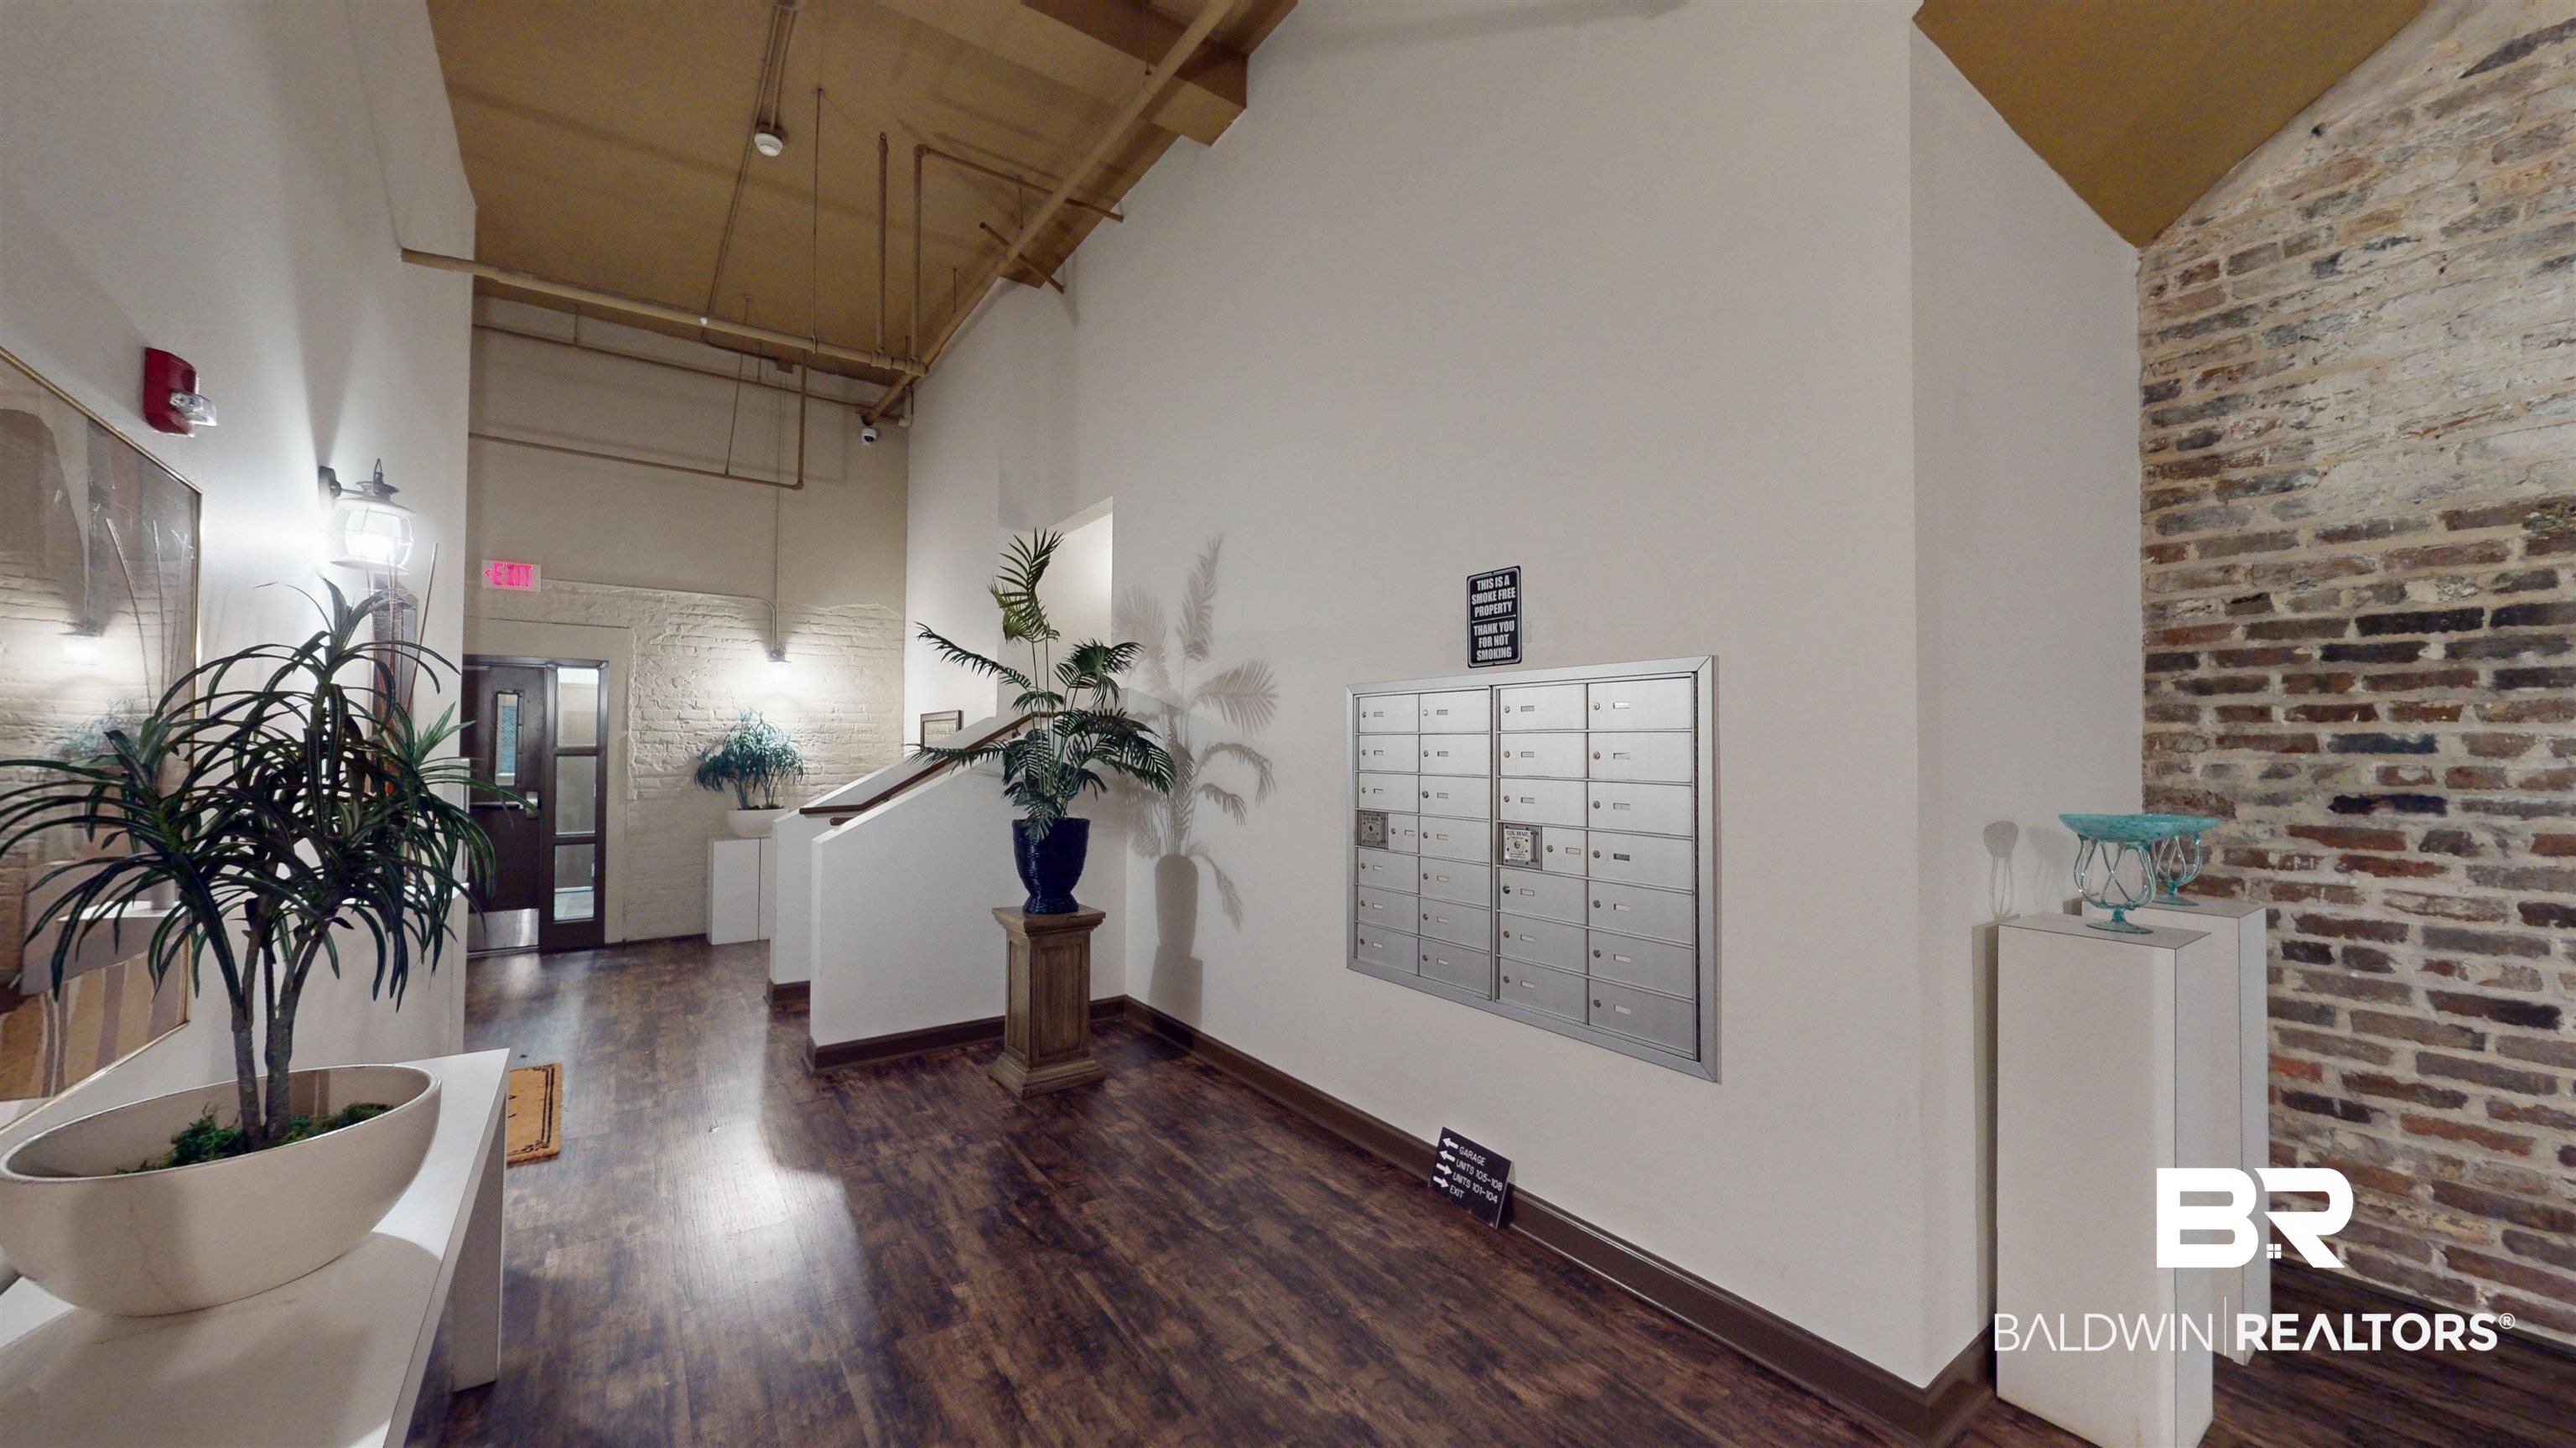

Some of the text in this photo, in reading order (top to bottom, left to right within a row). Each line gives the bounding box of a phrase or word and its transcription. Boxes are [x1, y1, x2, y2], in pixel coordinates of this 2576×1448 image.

[492, 561, 532, 588] EXIT
[1477, 574, 1509, 591] THIS IS A
[1472, 587, 1515, 605] SMOKE FREE
[1474, 601, 1513, 617] PROPERTY
[1473, 620, 1514, 636] THANK YOU
[1478, 634, 1509, 648] FOR NOT
[1477, 646, 1512, 661] SMOKING
[1459, 1146, 1486, 1166] GARAGE
[1456, 1159, 1504, 1191] UNITS 105-108
[1449, 1185, 1464, 1199] EXIT
[1452, 1171, 1498, 1203] UNITS 101-104
